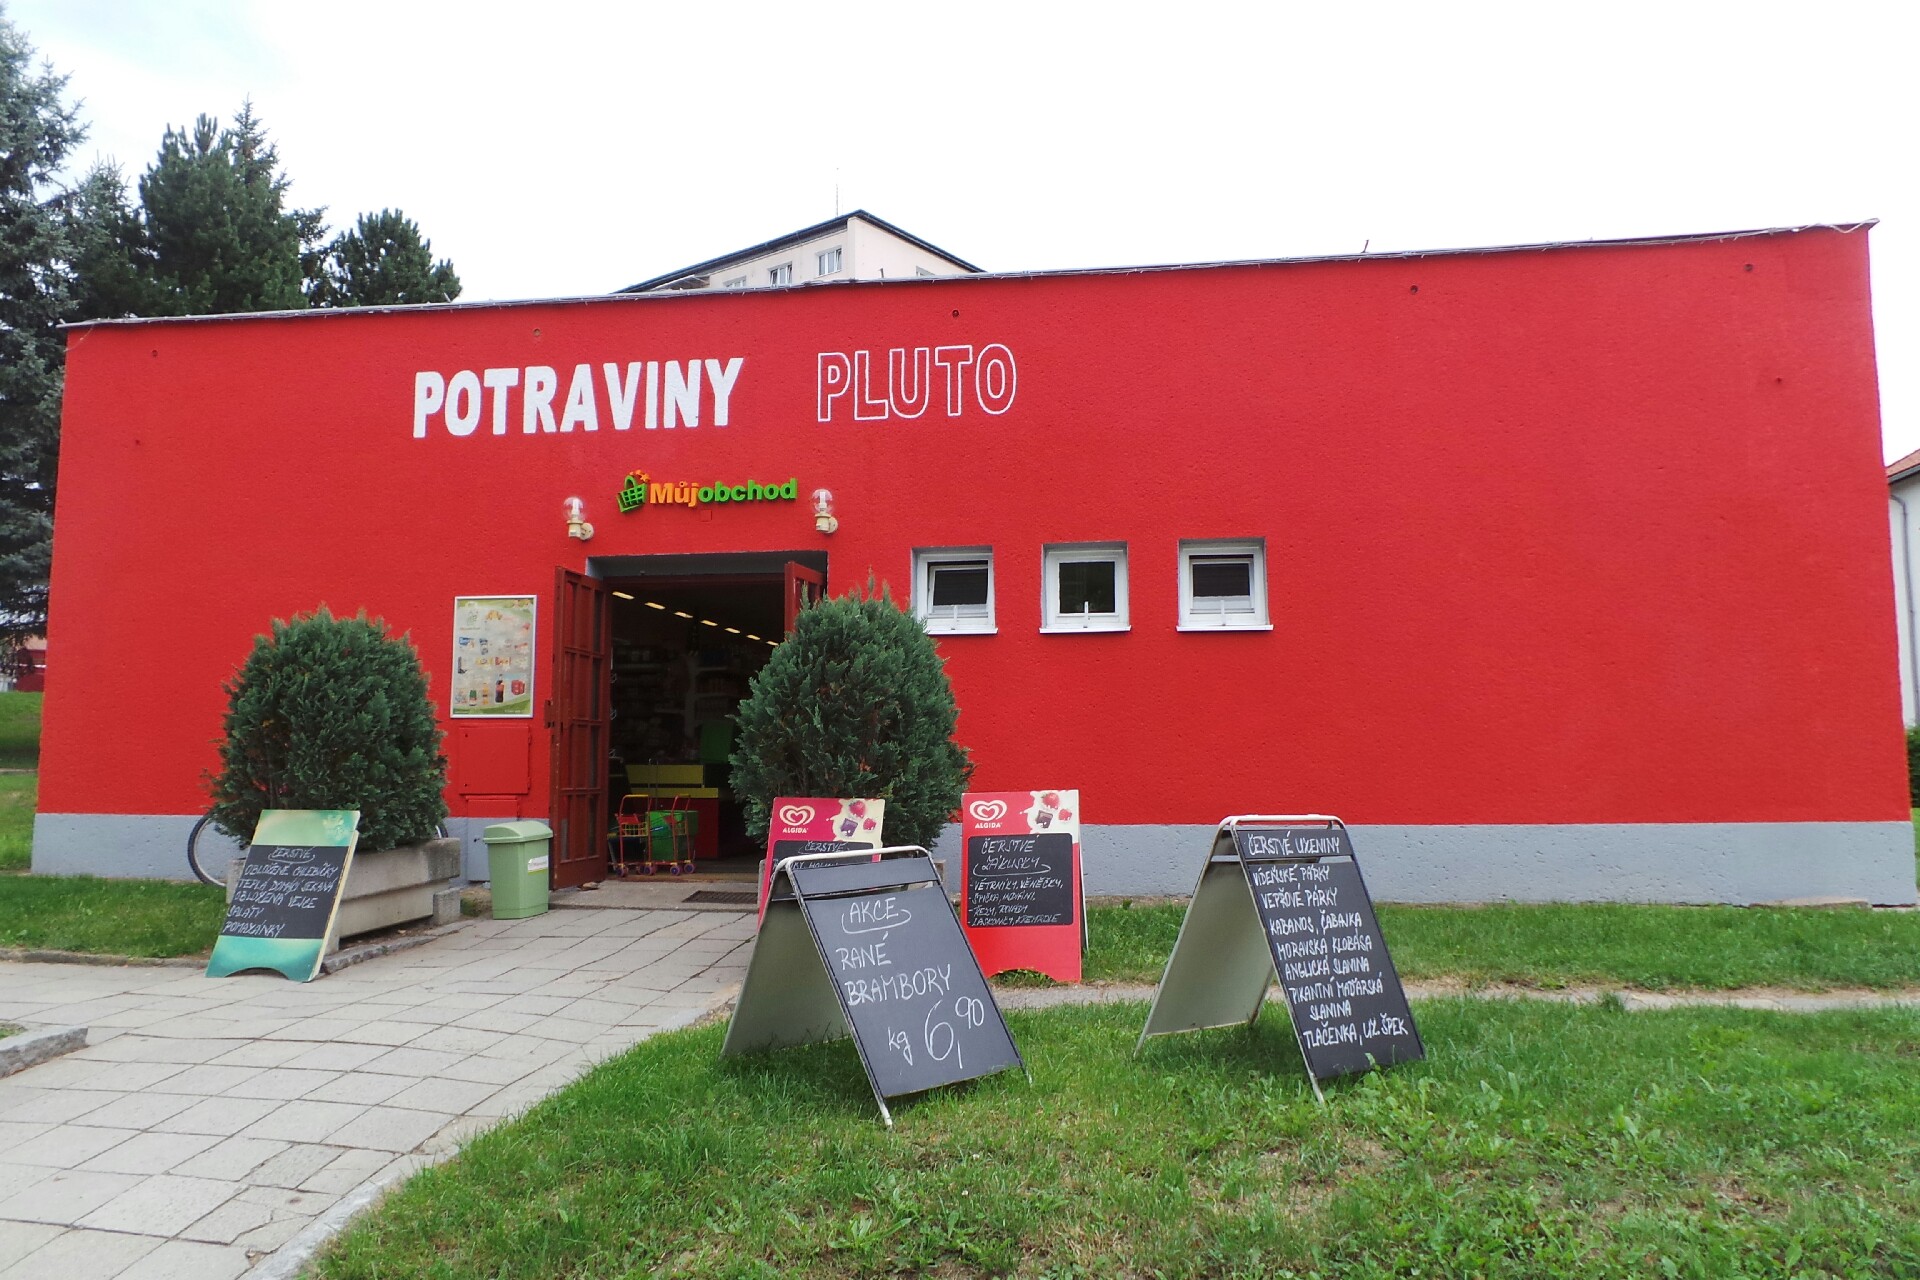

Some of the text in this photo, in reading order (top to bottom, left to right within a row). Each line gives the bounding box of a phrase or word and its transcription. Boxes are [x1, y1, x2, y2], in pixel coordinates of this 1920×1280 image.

[413, 344, 1016, 438] POTRAVINY PLUTO
[650, 478, 798, 508] Můjobchod
[981, 835, 1039, 854] ČERSTVÉ
[1248, 830, 1294, 856] ČERSTVÉ
[1252, 864, 1330, 886] VÍDEŇSKÉ PÁRKY
[288, 895, 318, 909] VEJCE
[1261, 883, 1338, 909] VEPŘOVÉ PÁRKY
[849, 897, 899, 923] AKCE
[1269, 916, 1319, 935] KABANOS,
[835, 931, 892, 971] RANÉ
[1332, 930, 1372, 954] KLOBÁSA
[1284, 955, 1370, 981] ANGLICKÁ SLANINA
[844, 963, 951, 1006] BRAMBORY
[1288, 976, 1335, 1005] PIKANTNÍ
[1310, 1000, 1352, 1021] SLANINA
[1380, 1012, 1409, 1036] ŠPEK
[887, 1026, 913, 1066] kg
